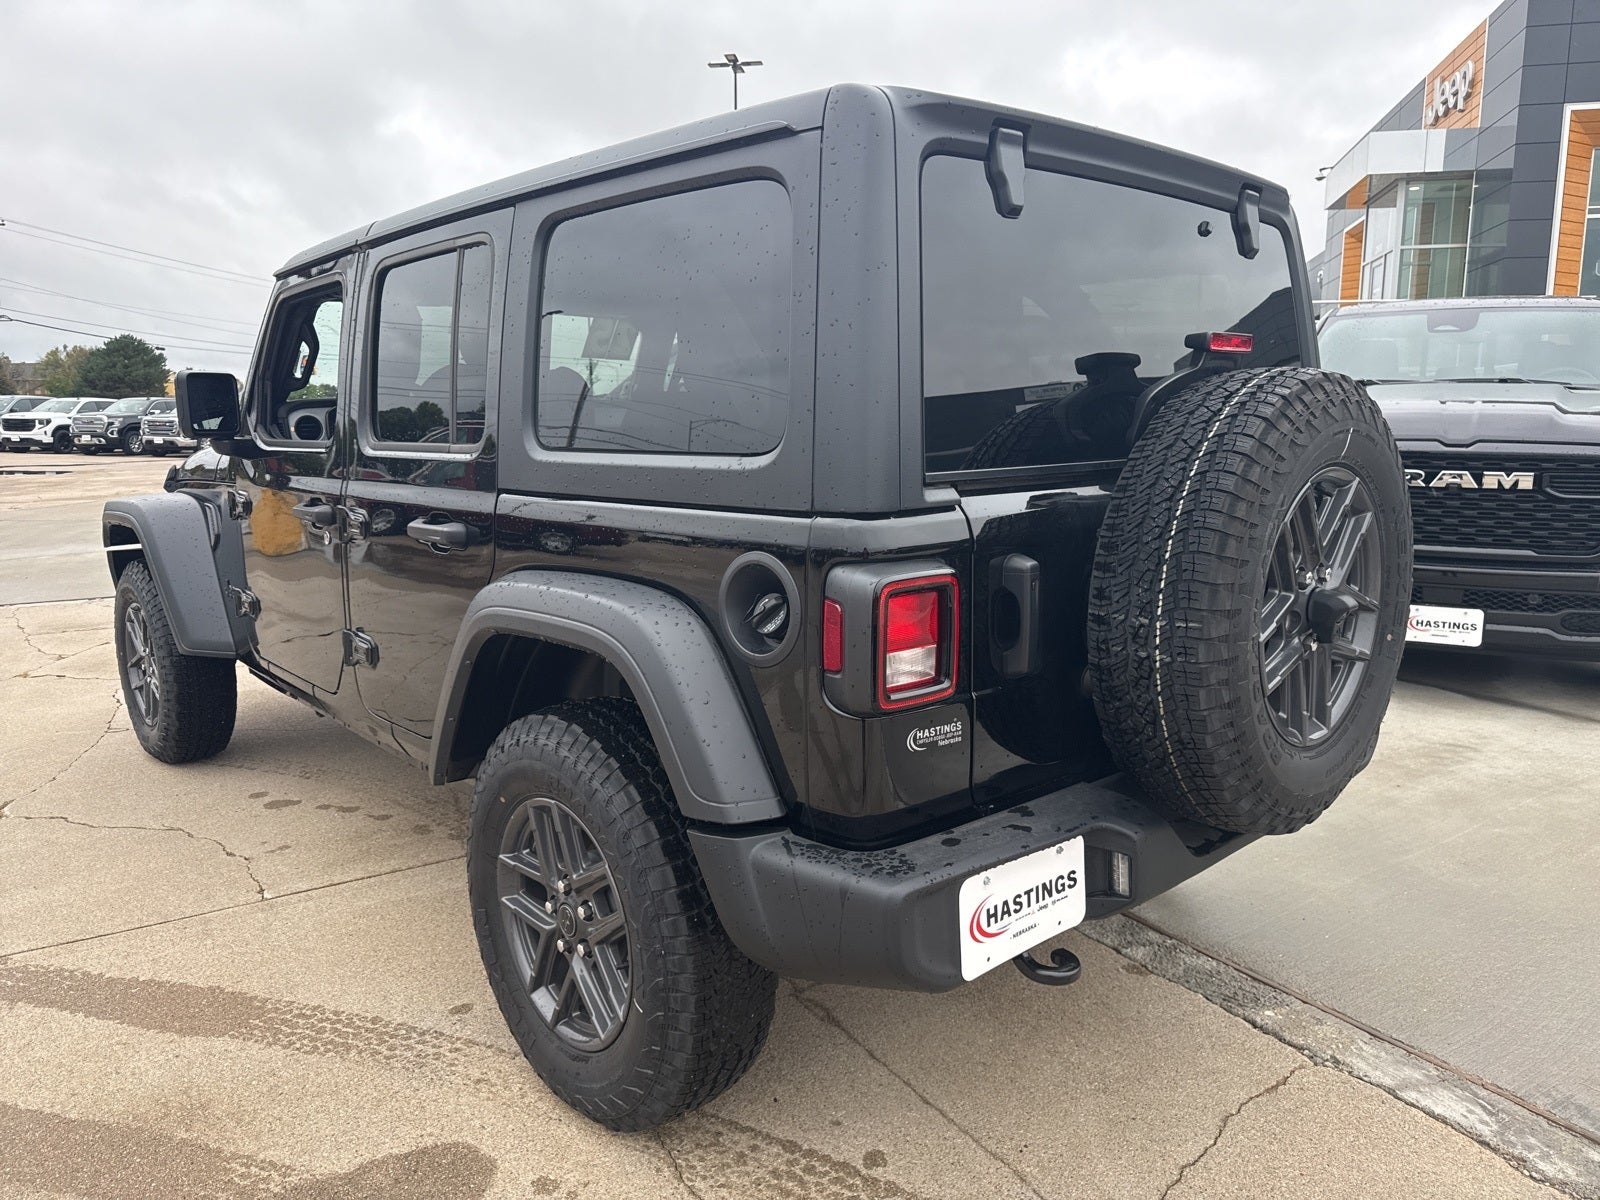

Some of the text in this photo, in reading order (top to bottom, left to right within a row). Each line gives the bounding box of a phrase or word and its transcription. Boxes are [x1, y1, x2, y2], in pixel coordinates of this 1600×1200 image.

[1426, 60, 1475, 127] Jeep
[1416, 619, 1478, 631] HASTINGS
[916, 721, 962, 739] HASTINGS
[937, 736, 962, 747] Nebraska
[986, 869, 1078, 928] HASTINGS
[1012, 922, 1037, 939] NEBRASKA
